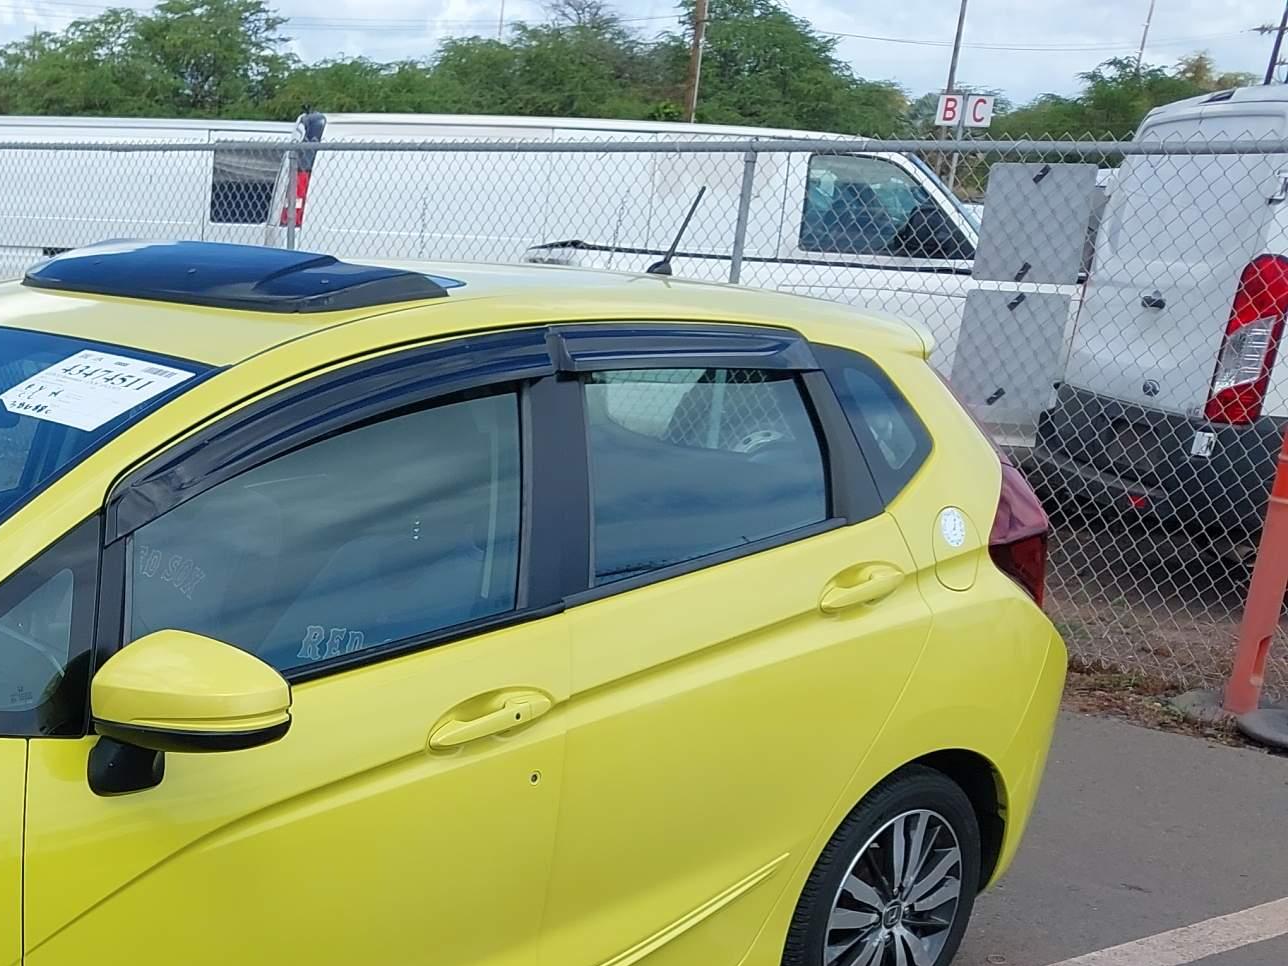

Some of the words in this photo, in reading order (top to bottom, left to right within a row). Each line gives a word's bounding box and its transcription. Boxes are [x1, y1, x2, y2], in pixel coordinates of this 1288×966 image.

[942, 97, 958, 121] B
[972, 98, 987, 123] C
[61, 363, 155, 391] 43474511
